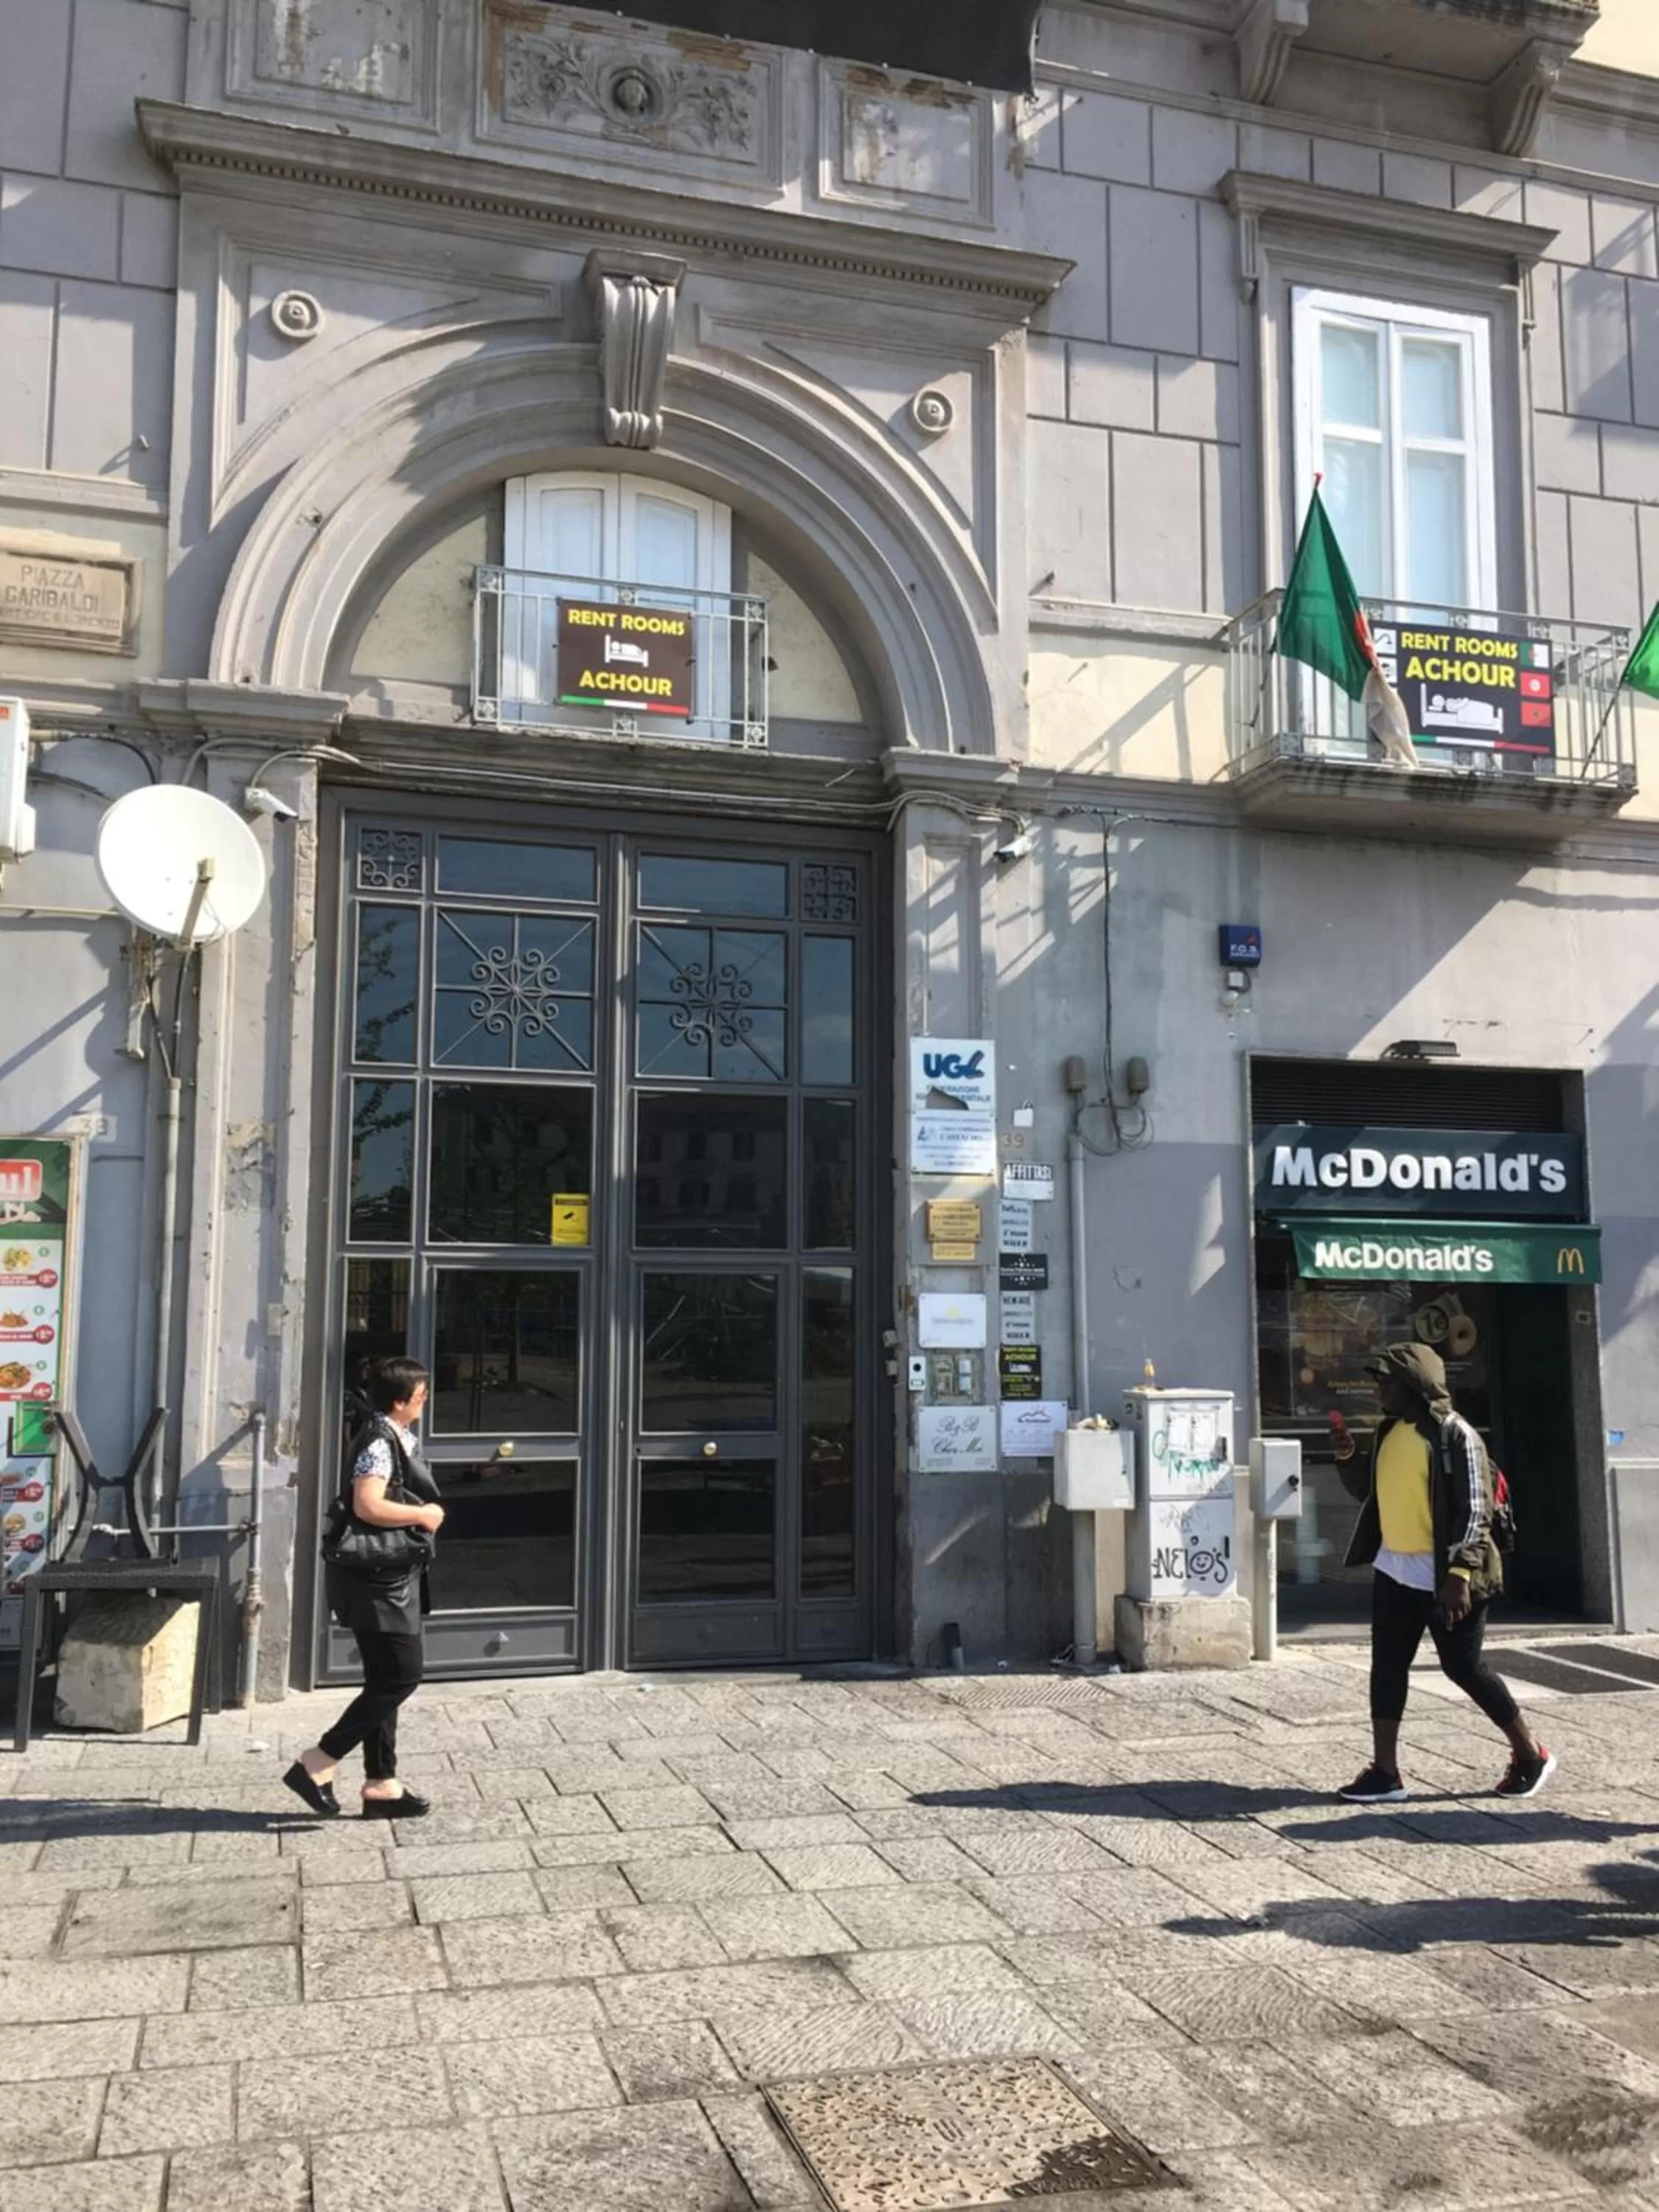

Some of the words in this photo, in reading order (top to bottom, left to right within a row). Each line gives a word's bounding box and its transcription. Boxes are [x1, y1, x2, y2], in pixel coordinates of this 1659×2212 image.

[21, 565, 84, 590] PIAZZA
[4, 585, 100, 613] GARIBALDI
[568, 608, 616, 627] RENT
[622, 614, 685, 636] ROOMS
[1401, 631, 1450, 652] RENT
[1455, 636, 1519, 660] ROOMS
[579, 669, 673, 697] ACHOUR
[1405, 655, 1516, 689] ACHOUR
[922, 1050, 985, 1080] UGL
[1002, 1132, 1025, 1149] 39
[1271, 1145, 1568, 1193] McDonald's
[1315, 1241, 1494, 1273] McDonald's
